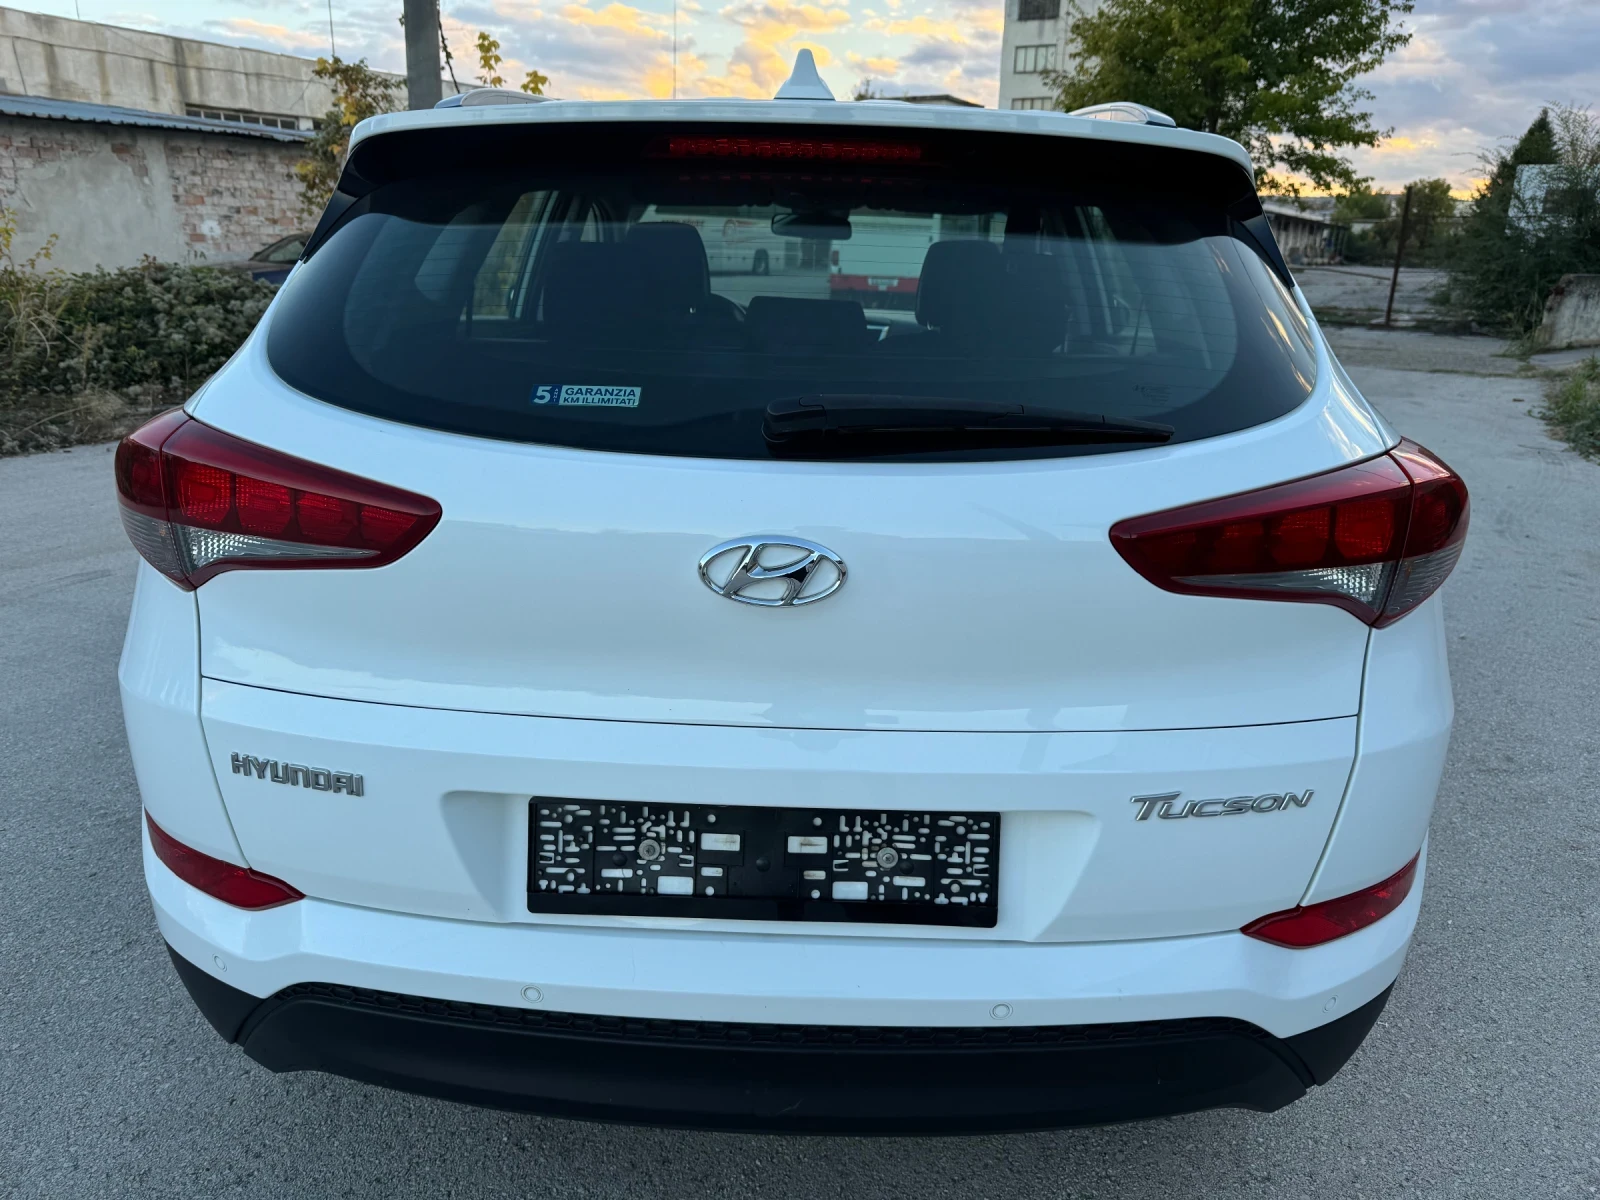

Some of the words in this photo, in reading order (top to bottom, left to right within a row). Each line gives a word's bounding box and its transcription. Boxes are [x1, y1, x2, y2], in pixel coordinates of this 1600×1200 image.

[533, 386, 552, 404] 5
[565, 387, 636, 397] GARANZIA
[581, 397, 636, 406] ILLIMITATI
[230, 751, 365, 797] HYUNDAI
[1130, 789, 1315, 822] TUCSON
